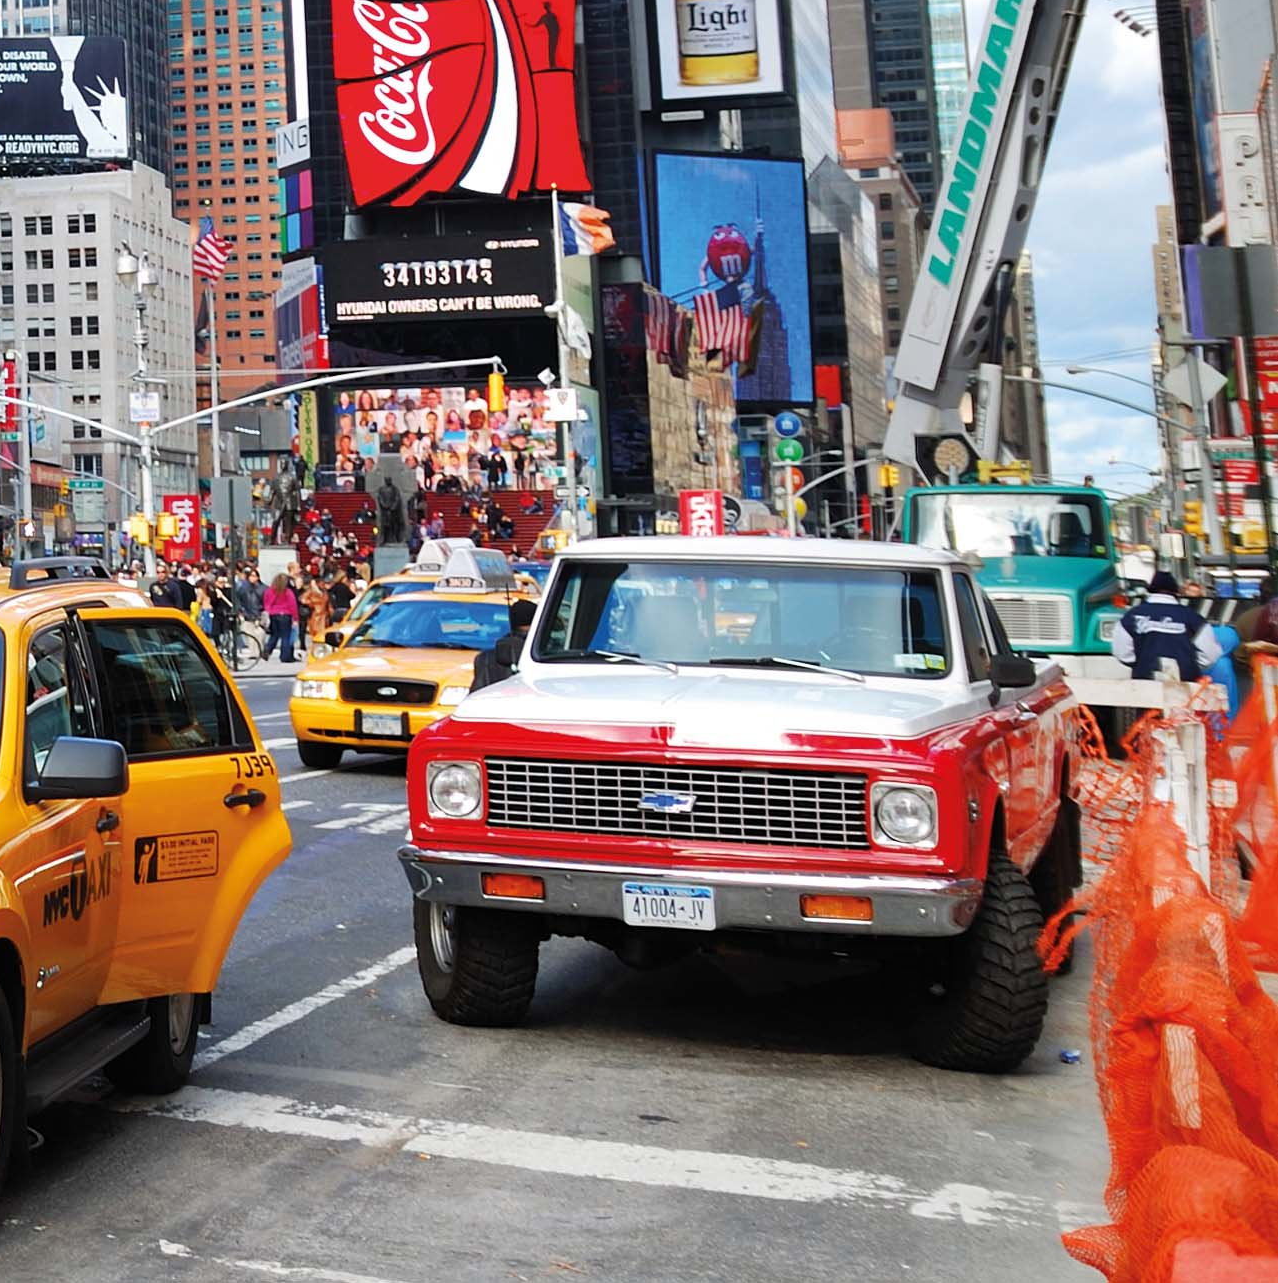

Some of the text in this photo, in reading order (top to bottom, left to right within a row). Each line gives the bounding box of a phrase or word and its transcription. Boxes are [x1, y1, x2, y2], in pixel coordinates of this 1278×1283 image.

[687, 3, 747, 32] Light
[3, 51, 48, 60] DISASTER
[20, 62, 56, 71] WORLD
[5, 142, 79, 154] READYNYC.ORG
[336, 301, 387, 315] HYUNDAI
[388, 299, 438, 313] OWNERS
[439, 297, 474, 311] CAN'T
[475, 296, 492, 309] BE
[230, 755, 274, 779] 7J39
